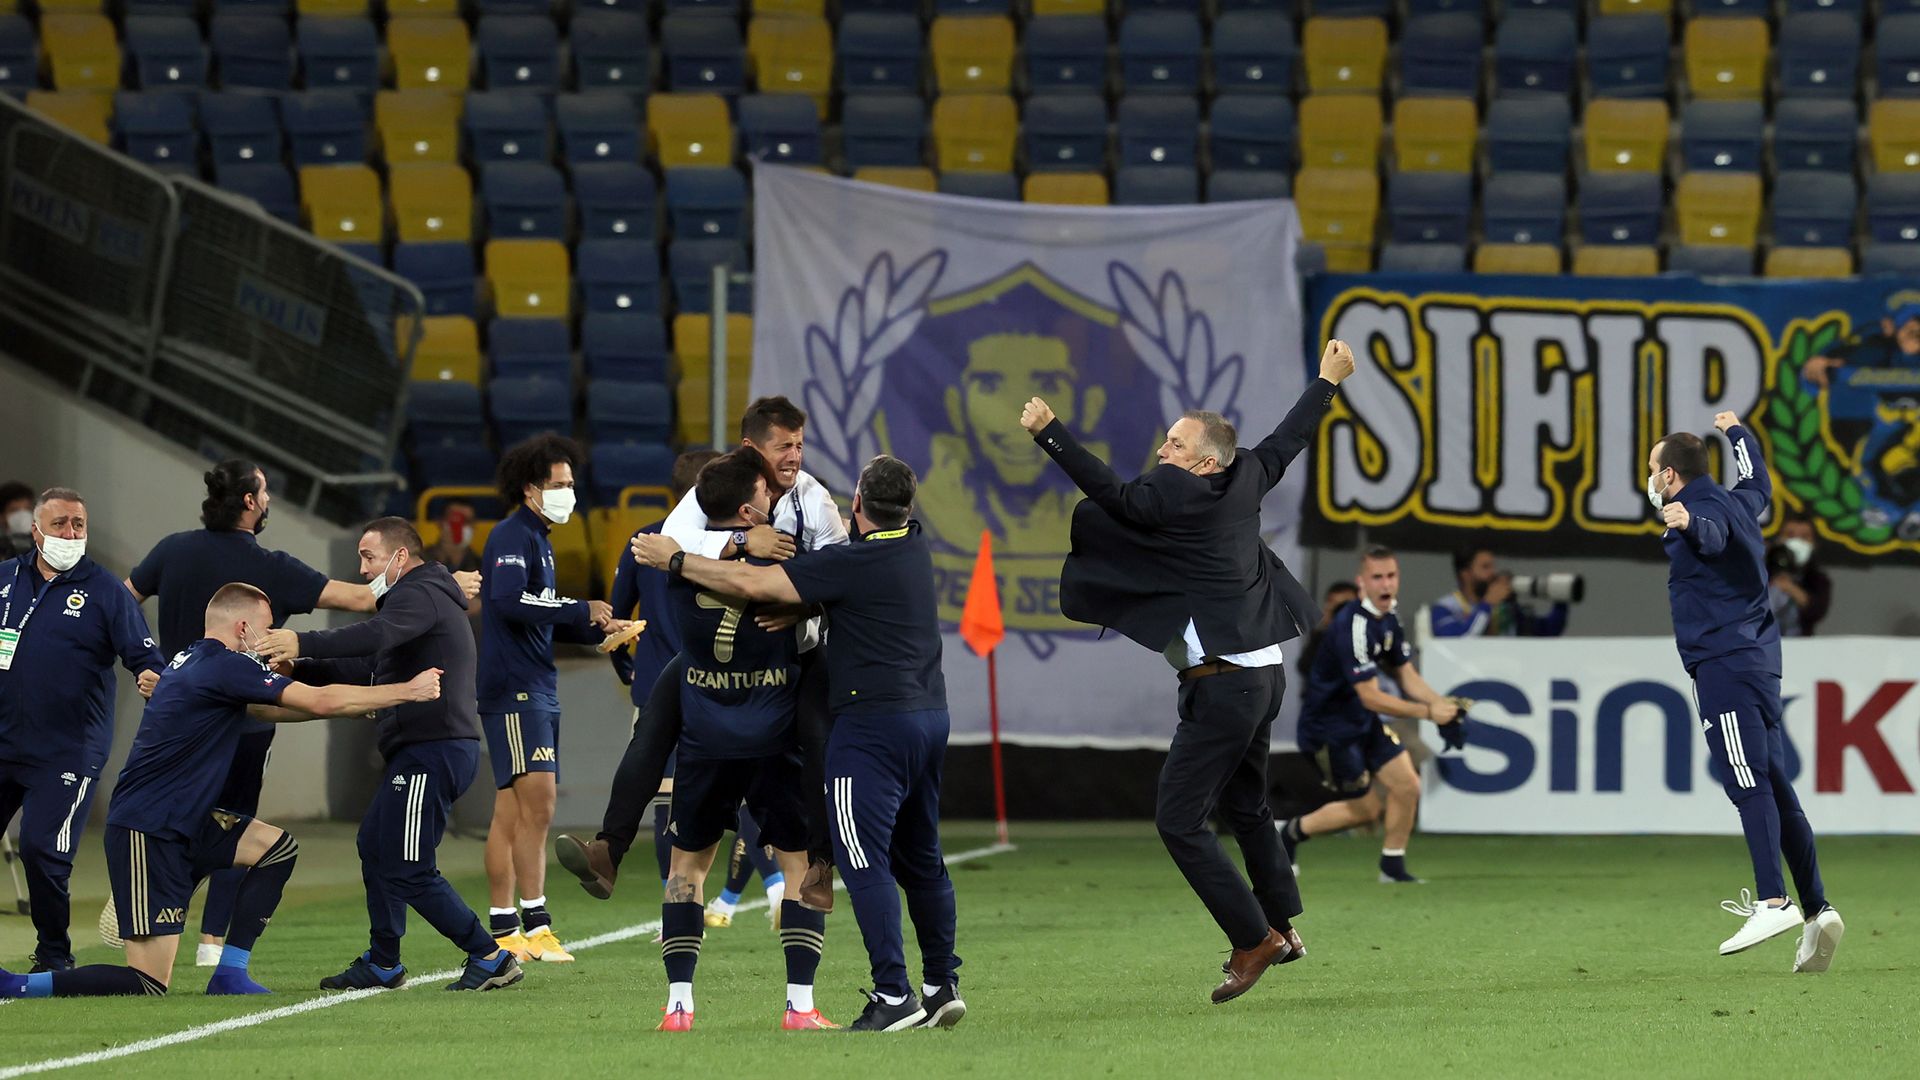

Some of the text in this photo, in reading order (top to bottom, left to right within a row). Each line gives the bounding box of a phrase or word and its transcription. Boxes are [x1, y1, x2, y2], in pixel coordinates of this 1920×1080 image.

[1328, 298, 1774, 524] SIFIR
[62, 608, 81, 618] AVIS
[695, 591, 748, 664] 7
[686, 666, 787, 690] OZAN TUFAN
